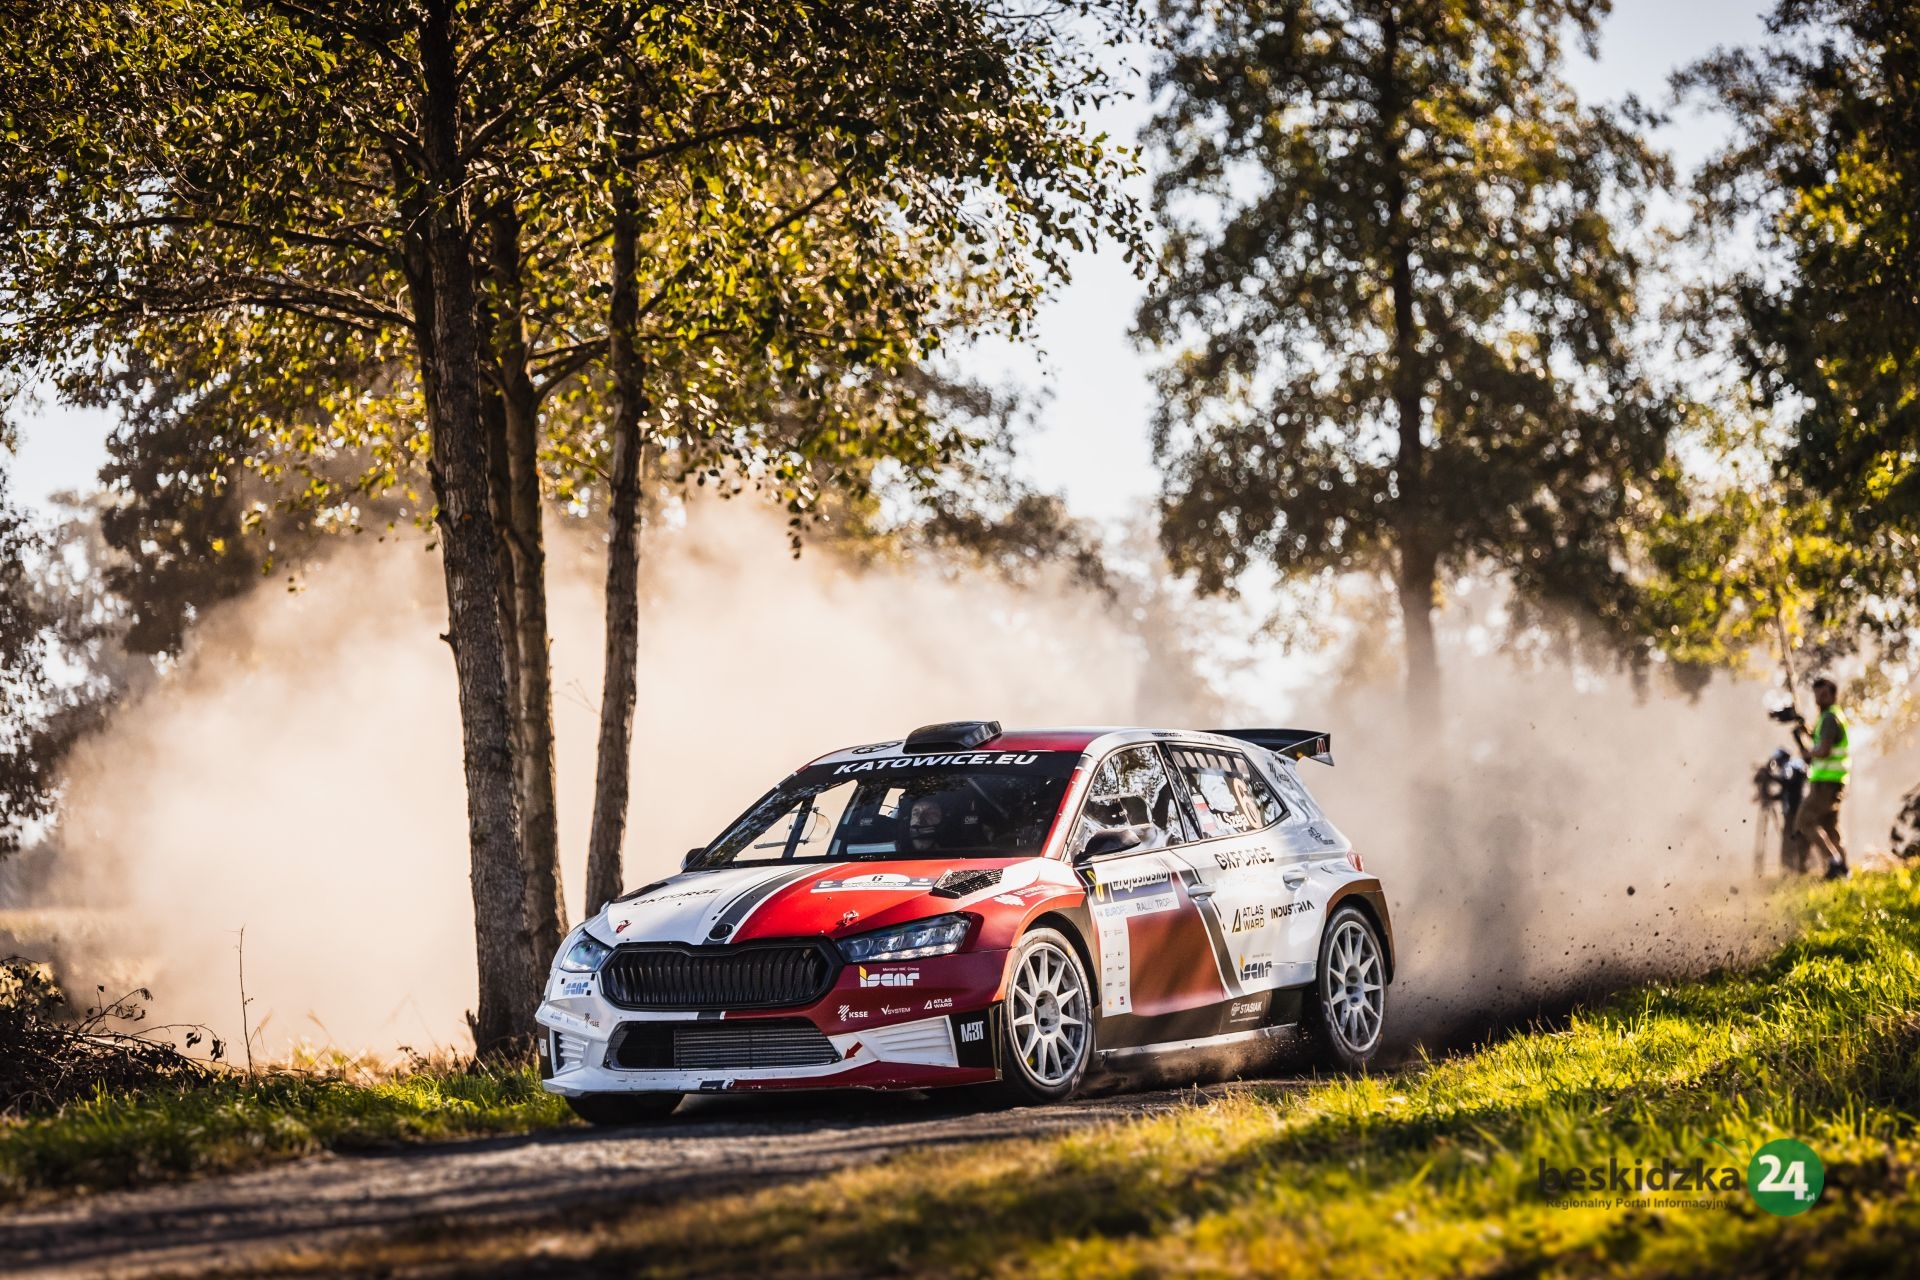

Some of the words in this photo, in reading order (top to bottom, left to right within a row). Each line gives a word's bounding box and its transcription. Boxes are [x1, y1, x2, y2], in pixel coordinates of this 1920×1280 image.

[833, 754, 1039, 775] KATOWICE.EU
[1242, 904, 1264, 918] ATLAS
[1270, 900, 1315, 920] INDUSTRIA
[1243, 918, 1265, 931] WARD
[1240, 1001, 1263, 1014] STASIAK
